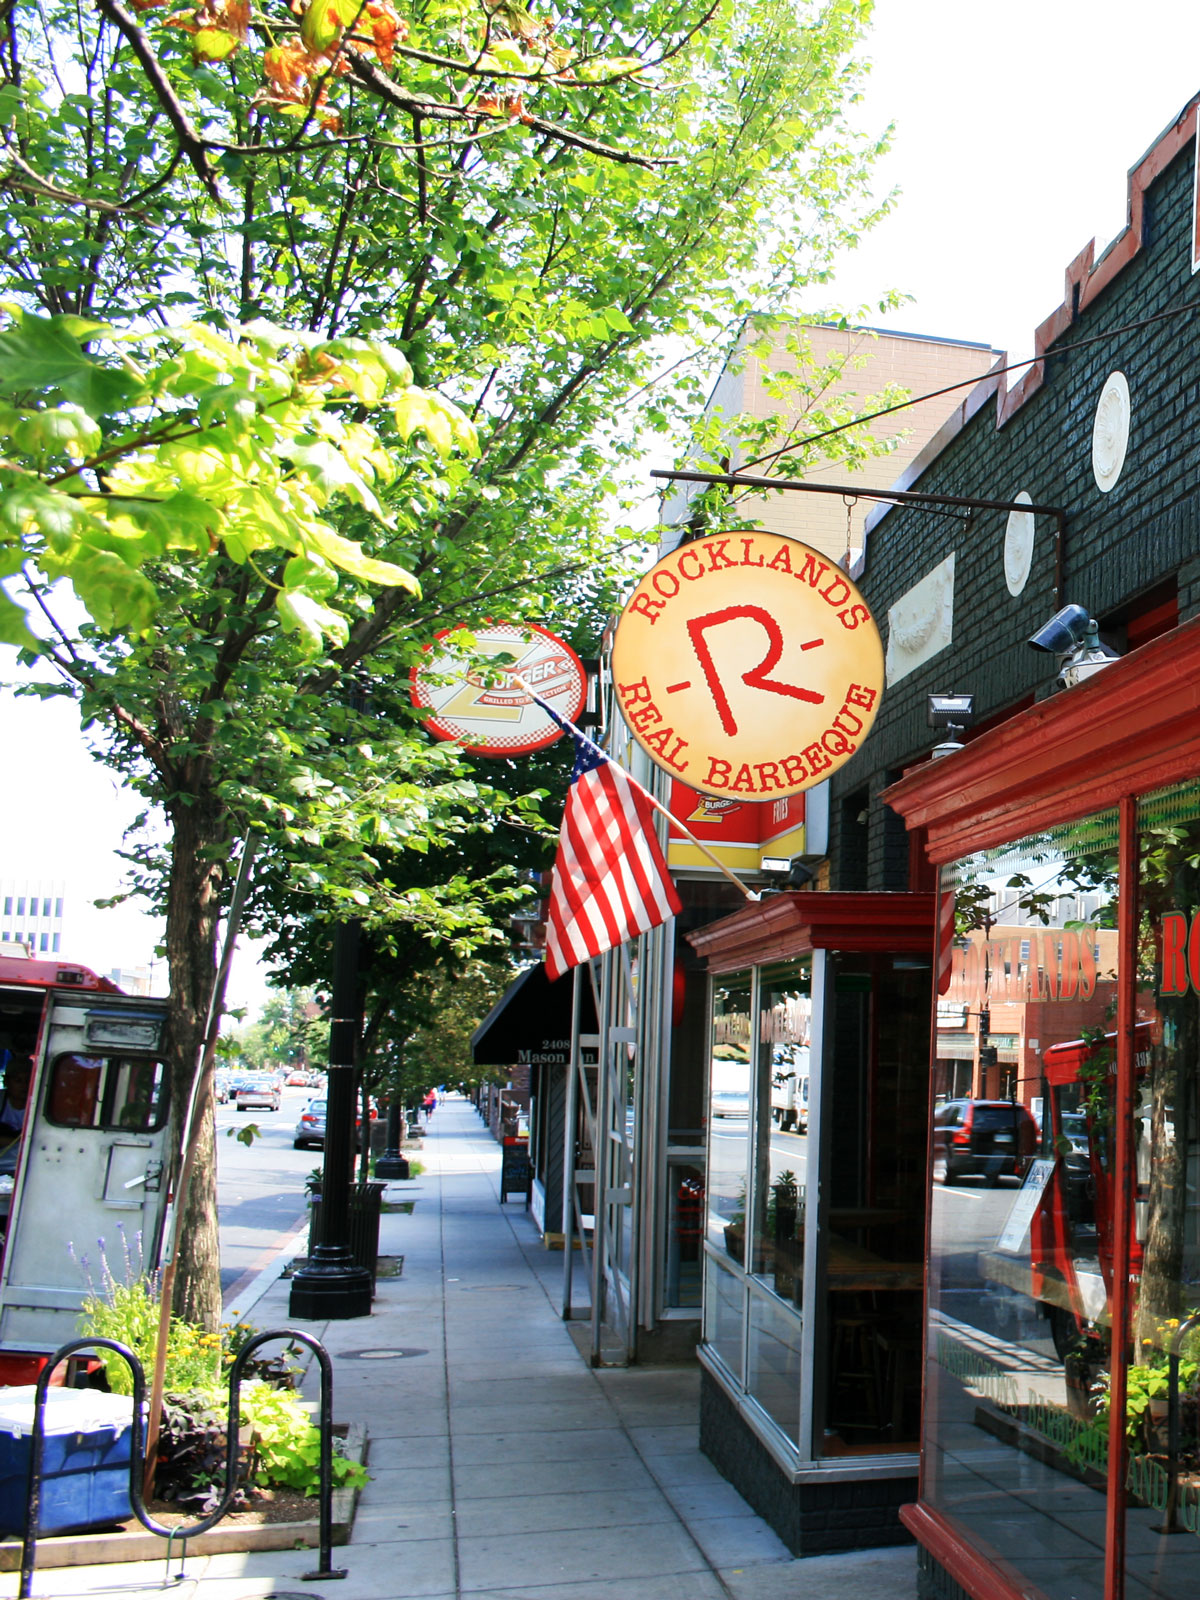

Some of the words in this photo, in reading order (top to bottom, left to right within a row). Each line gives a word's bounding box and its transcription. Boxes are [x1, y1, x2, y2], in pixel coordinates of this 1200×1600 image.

[629, 538, 870, 632] ROCKLANDS
[618, 675, 690, 773] REAL
[702, 683, 877, 793] BARBEQUE
[773, 797, 789, 824] FRIES
[517, 1049, 565, 1063] Mason
[542, 1039, 571, 1050] 2408
[1125, 1448, 1168, 1512] AND
